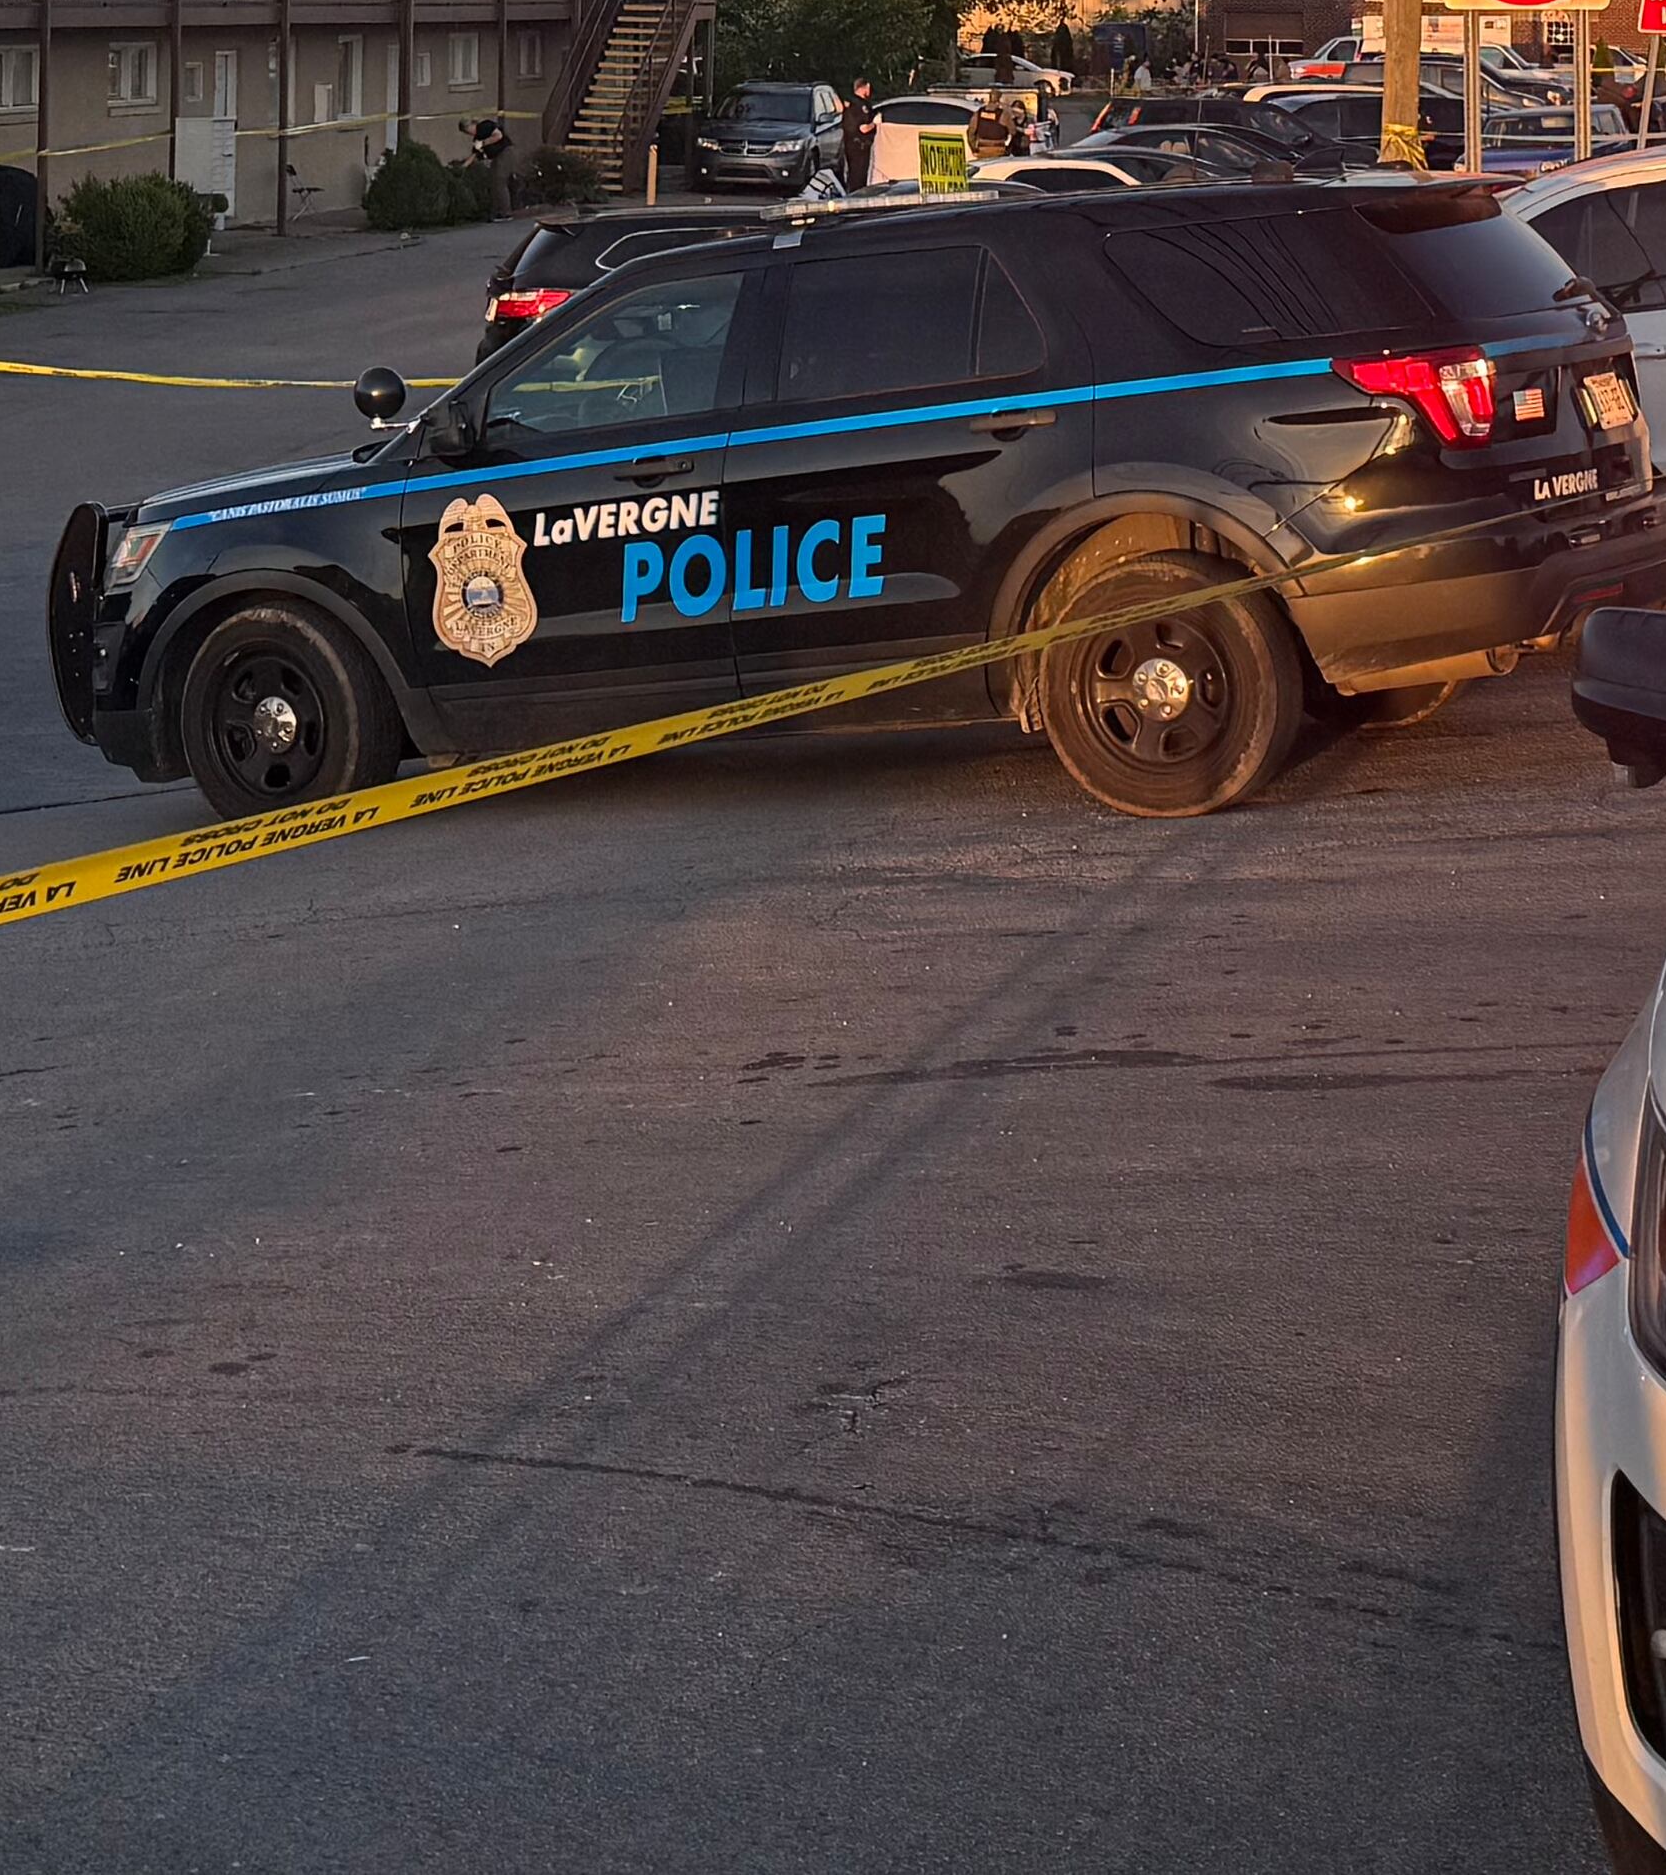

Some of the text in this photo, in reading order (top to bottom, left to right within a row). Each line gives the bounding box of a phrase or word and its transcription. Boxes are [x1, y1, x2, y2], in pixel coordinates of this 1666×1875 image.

[1534, 479, 1551, 501] LA
[1552, 468, 1598, 497] VERGNE
[533, 490, 720, 547] LaVERGNE
[621, 514, 887, 623] POLICE
[114, 805, 380, 884] LA VERGNE POLICE LINE
[46, 881, 77, 903] LA
